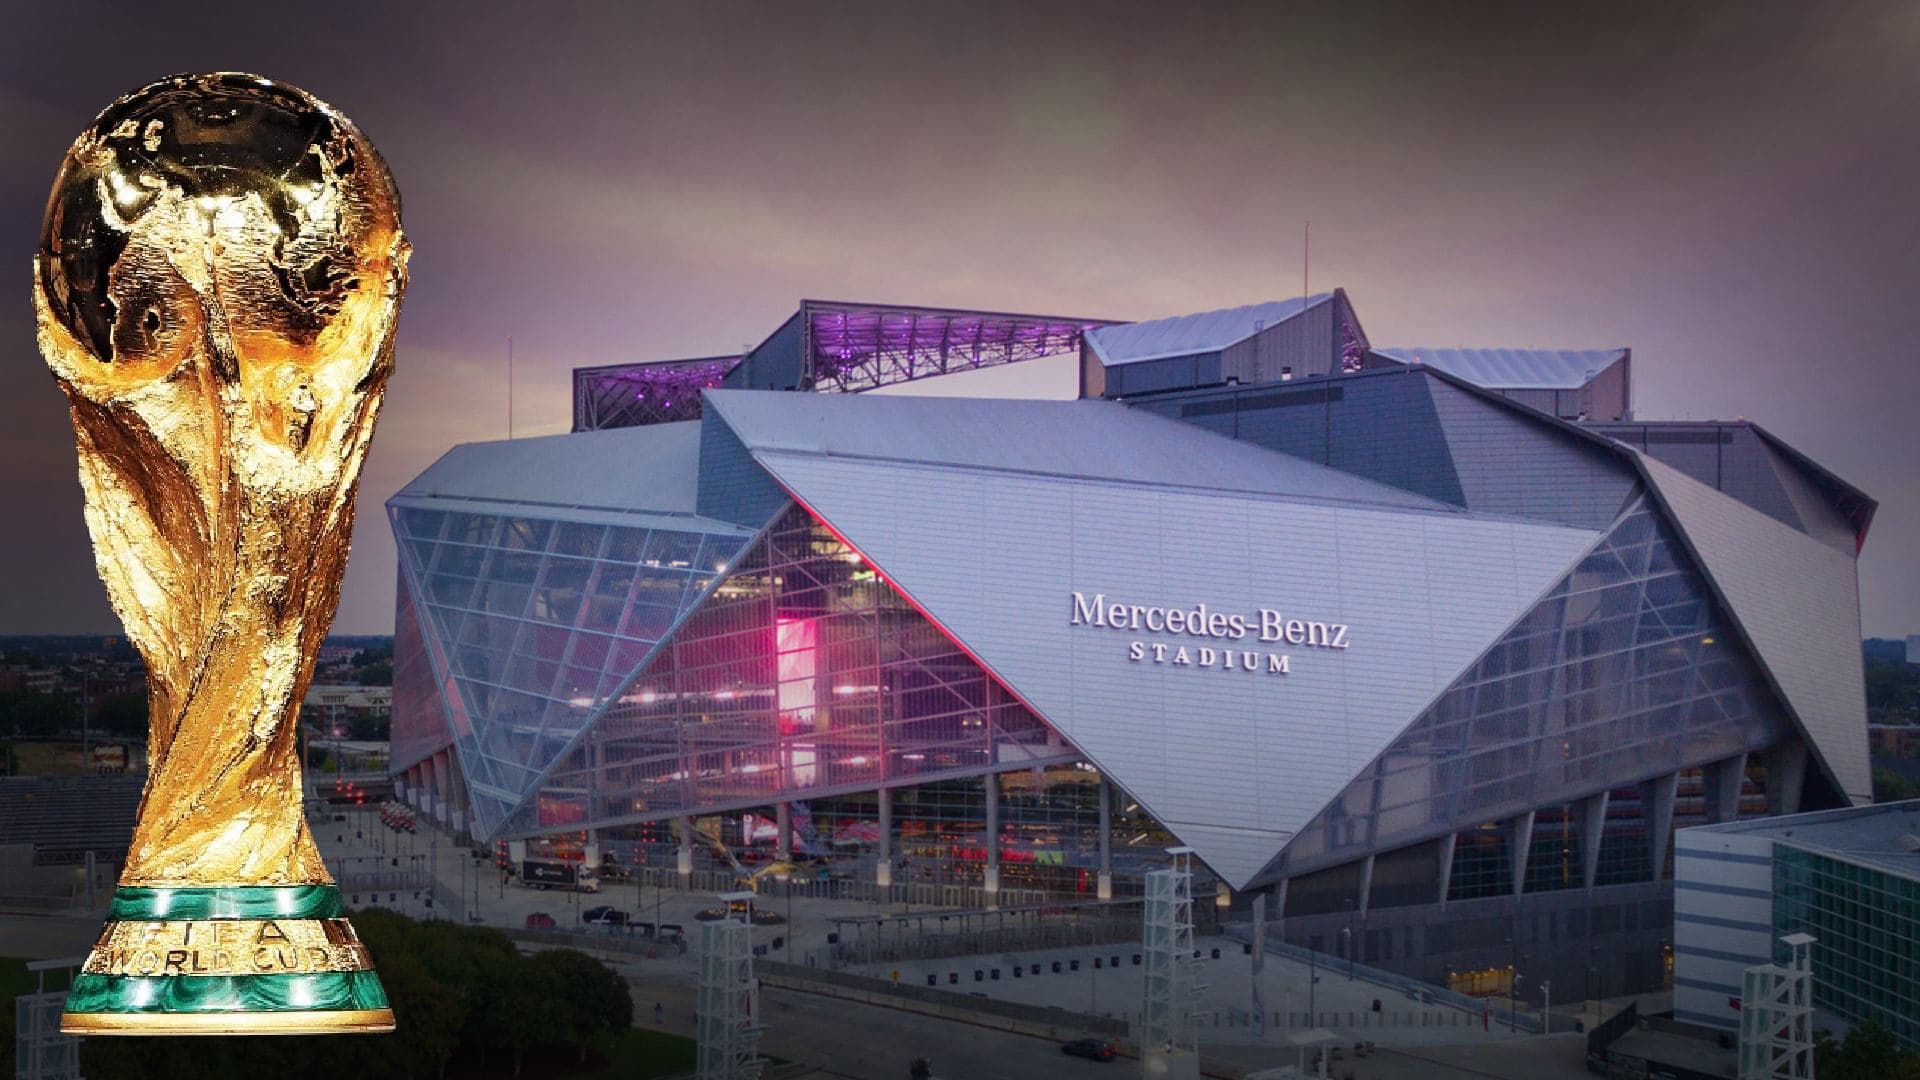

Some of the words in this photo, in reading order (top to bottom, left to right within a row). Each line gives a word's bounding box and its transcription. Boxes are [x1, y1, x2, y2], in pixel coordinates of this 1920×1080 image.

[1070, 591, 1350, 649] Mercedes-Benz
[1130, 641, 1291, 673] STADIUM
[141, 921, 291, 945] FIFA
[109, 949, 233, 974] WORLD
[252, 947, 330, 971] CUP
